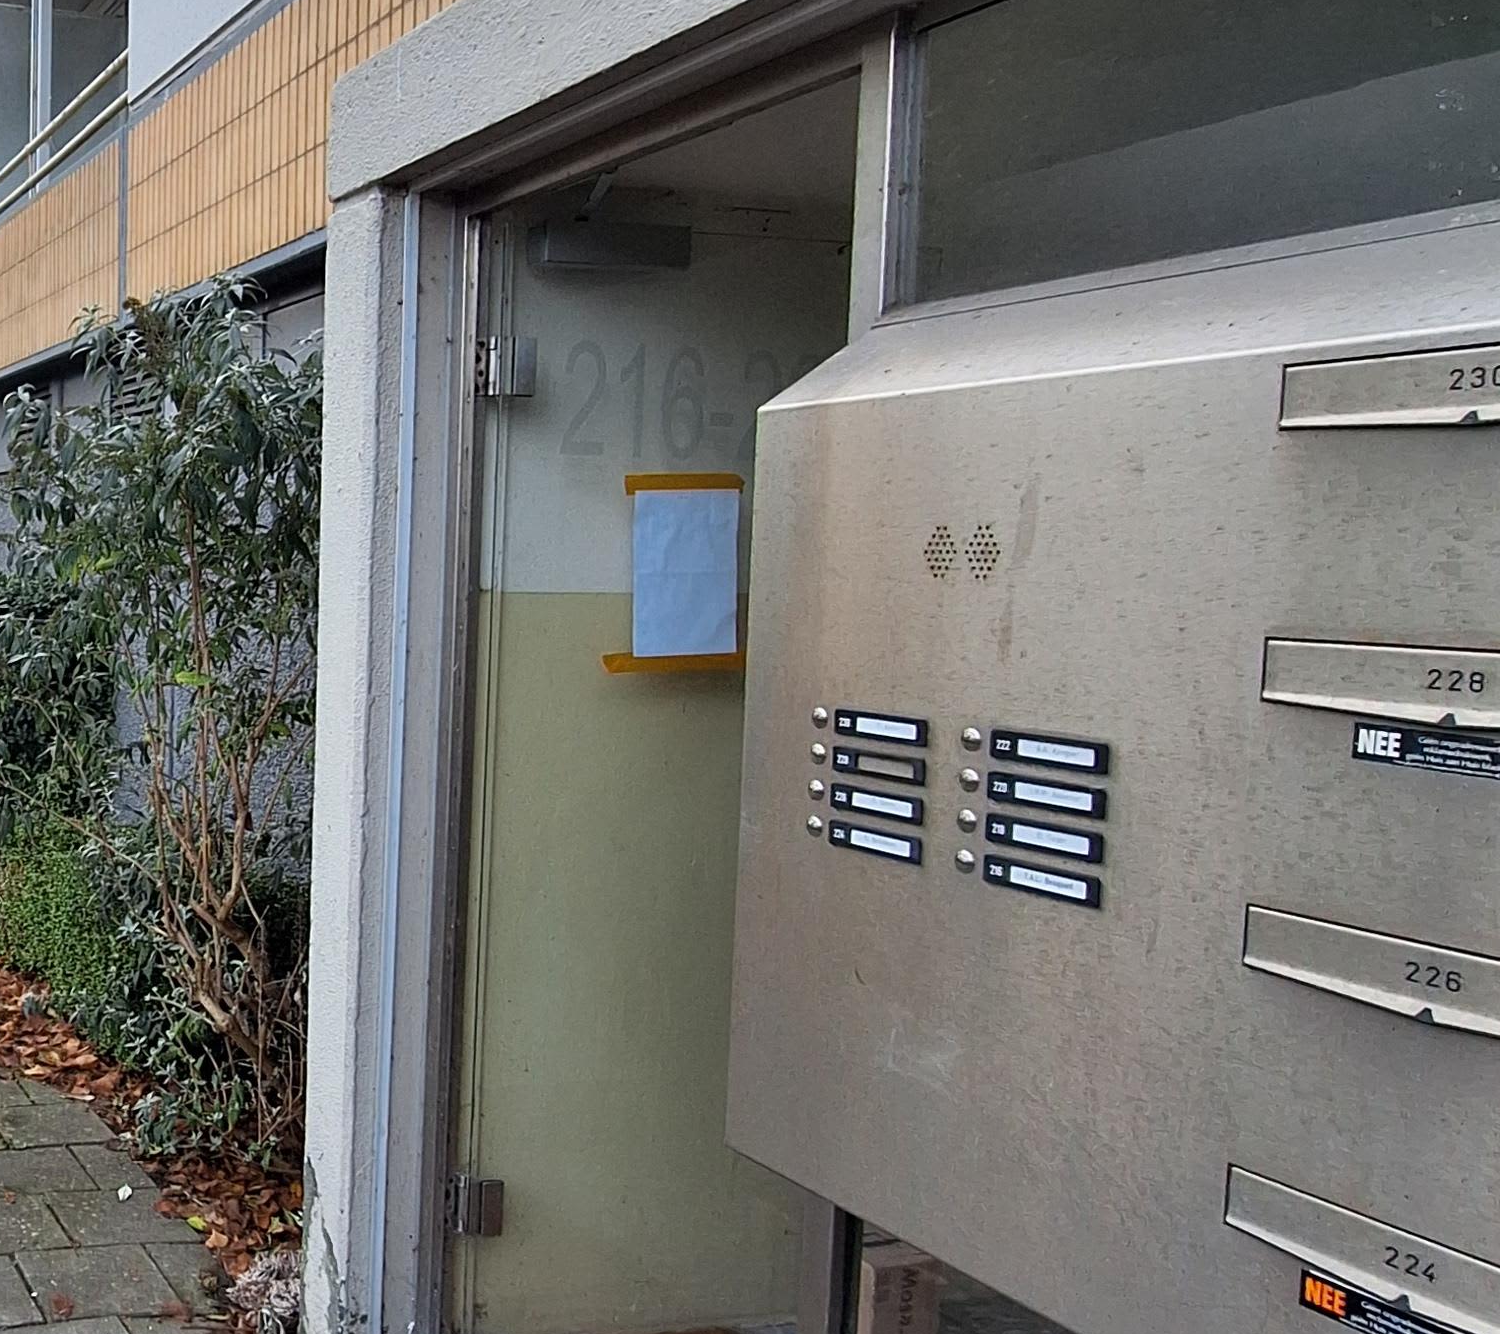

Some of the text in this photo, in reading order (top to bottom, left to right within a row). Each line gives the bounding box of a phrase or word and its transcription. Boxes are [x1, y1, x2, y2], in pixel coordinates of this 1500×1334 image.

[1427, 668, 1485, 693] 228
[996, 739, 1011, 751] 222
[1357, 728, 1402, 758] NEE
[1404, 960, 1463, 993] 226
[1384, 1246, 1437, 1283] 224
[1305, 1276, 1347, 1317] NEE
